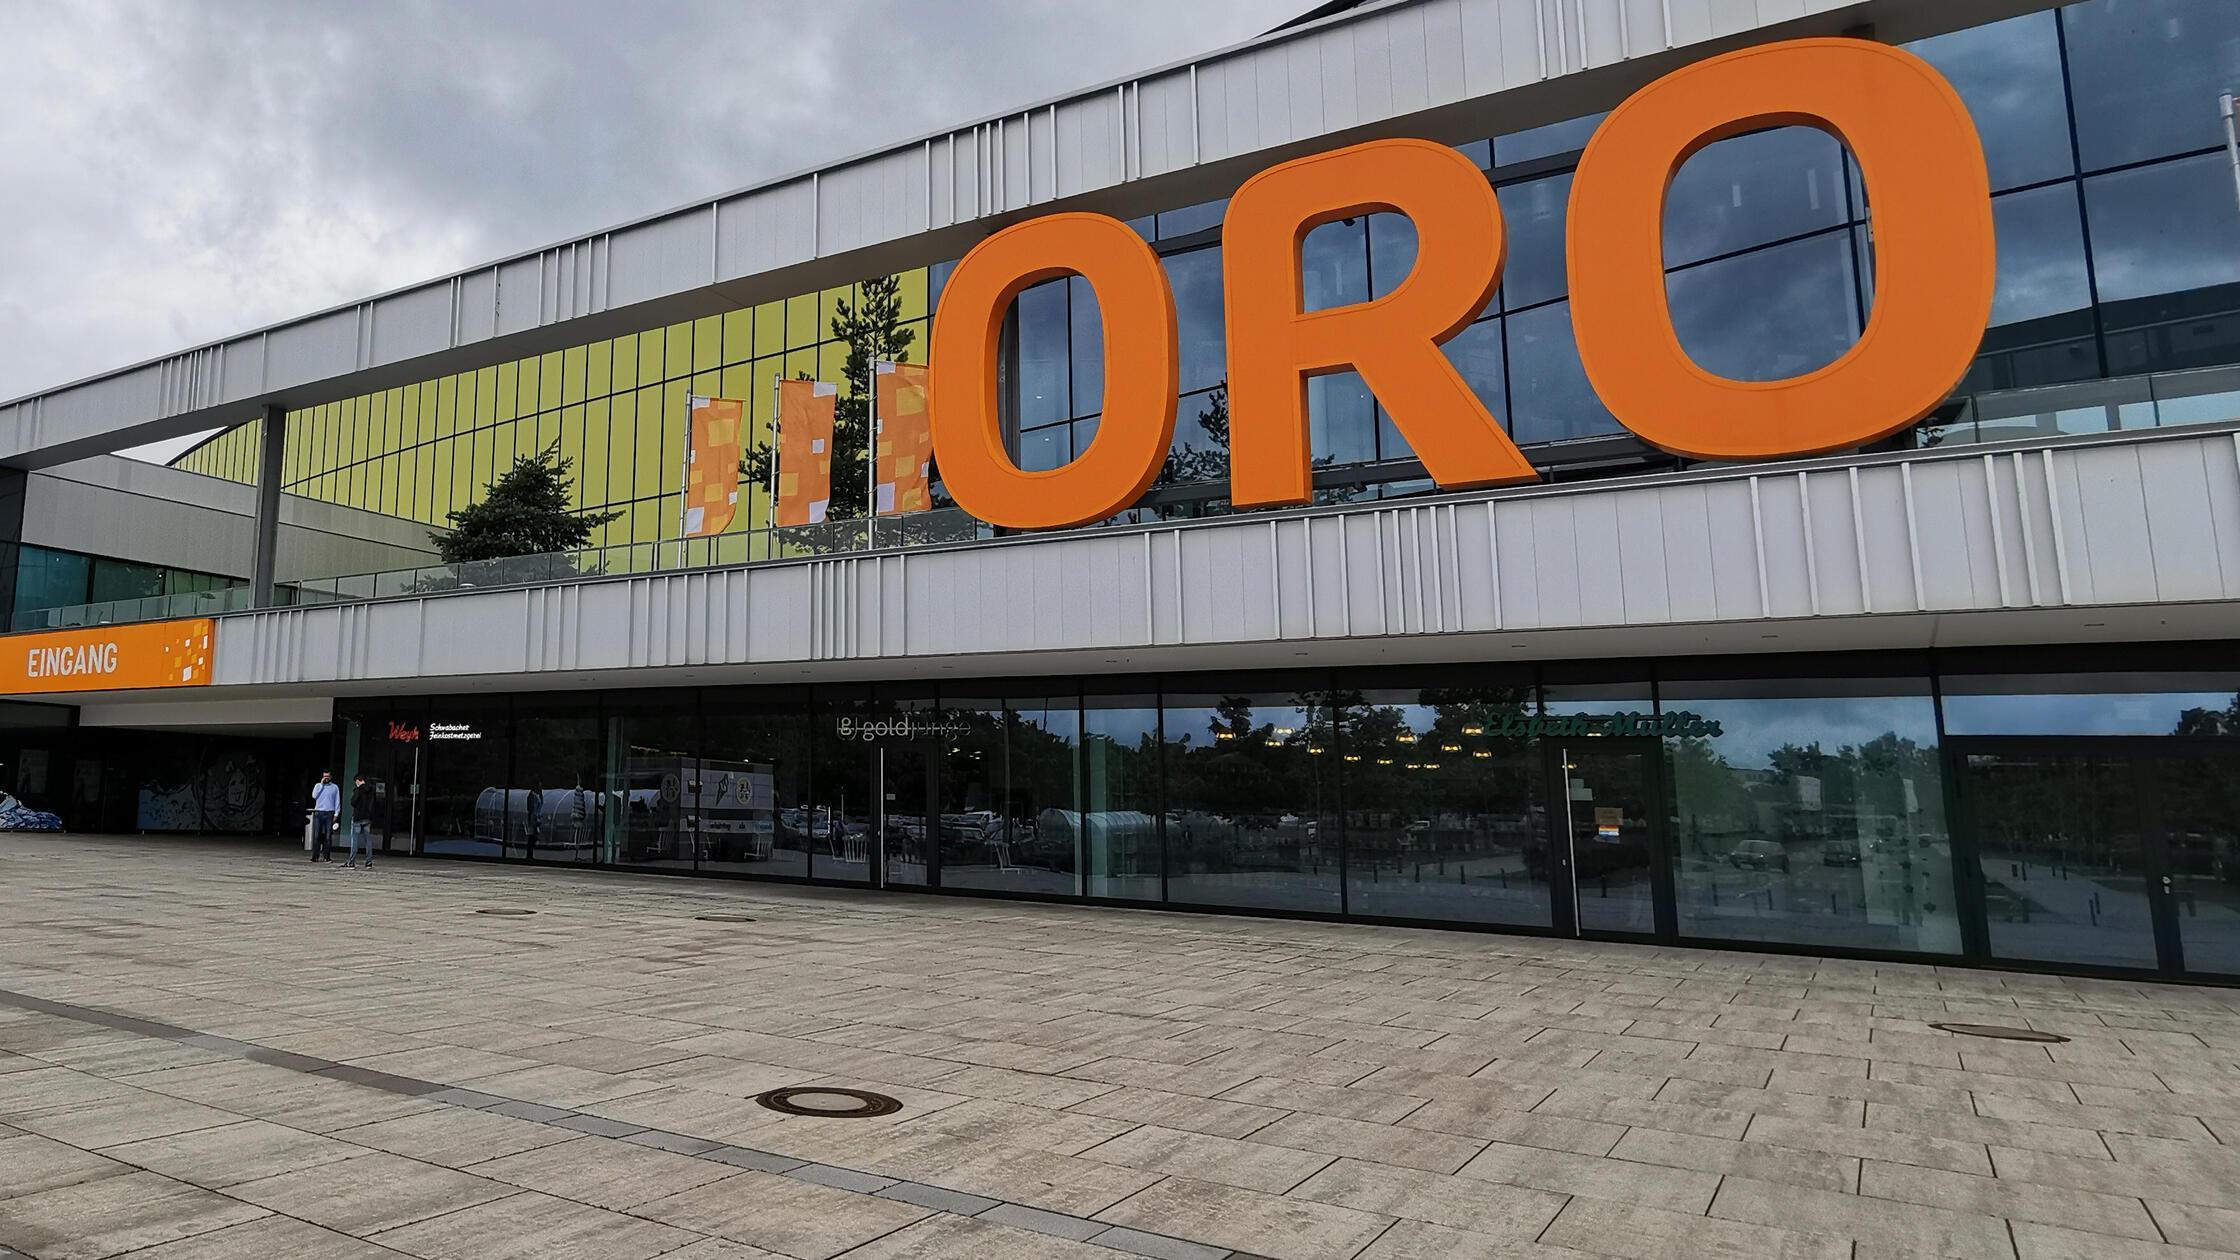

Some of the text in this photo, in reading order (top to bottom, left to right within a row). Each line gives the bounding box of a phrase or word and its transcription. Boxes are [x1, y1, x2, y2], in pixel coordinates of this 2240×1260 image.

[929, 37, 1995, 529] ORO
[28, 642, 118, 677] EINGANG
[863, 716, 971, 741] goldjunge
